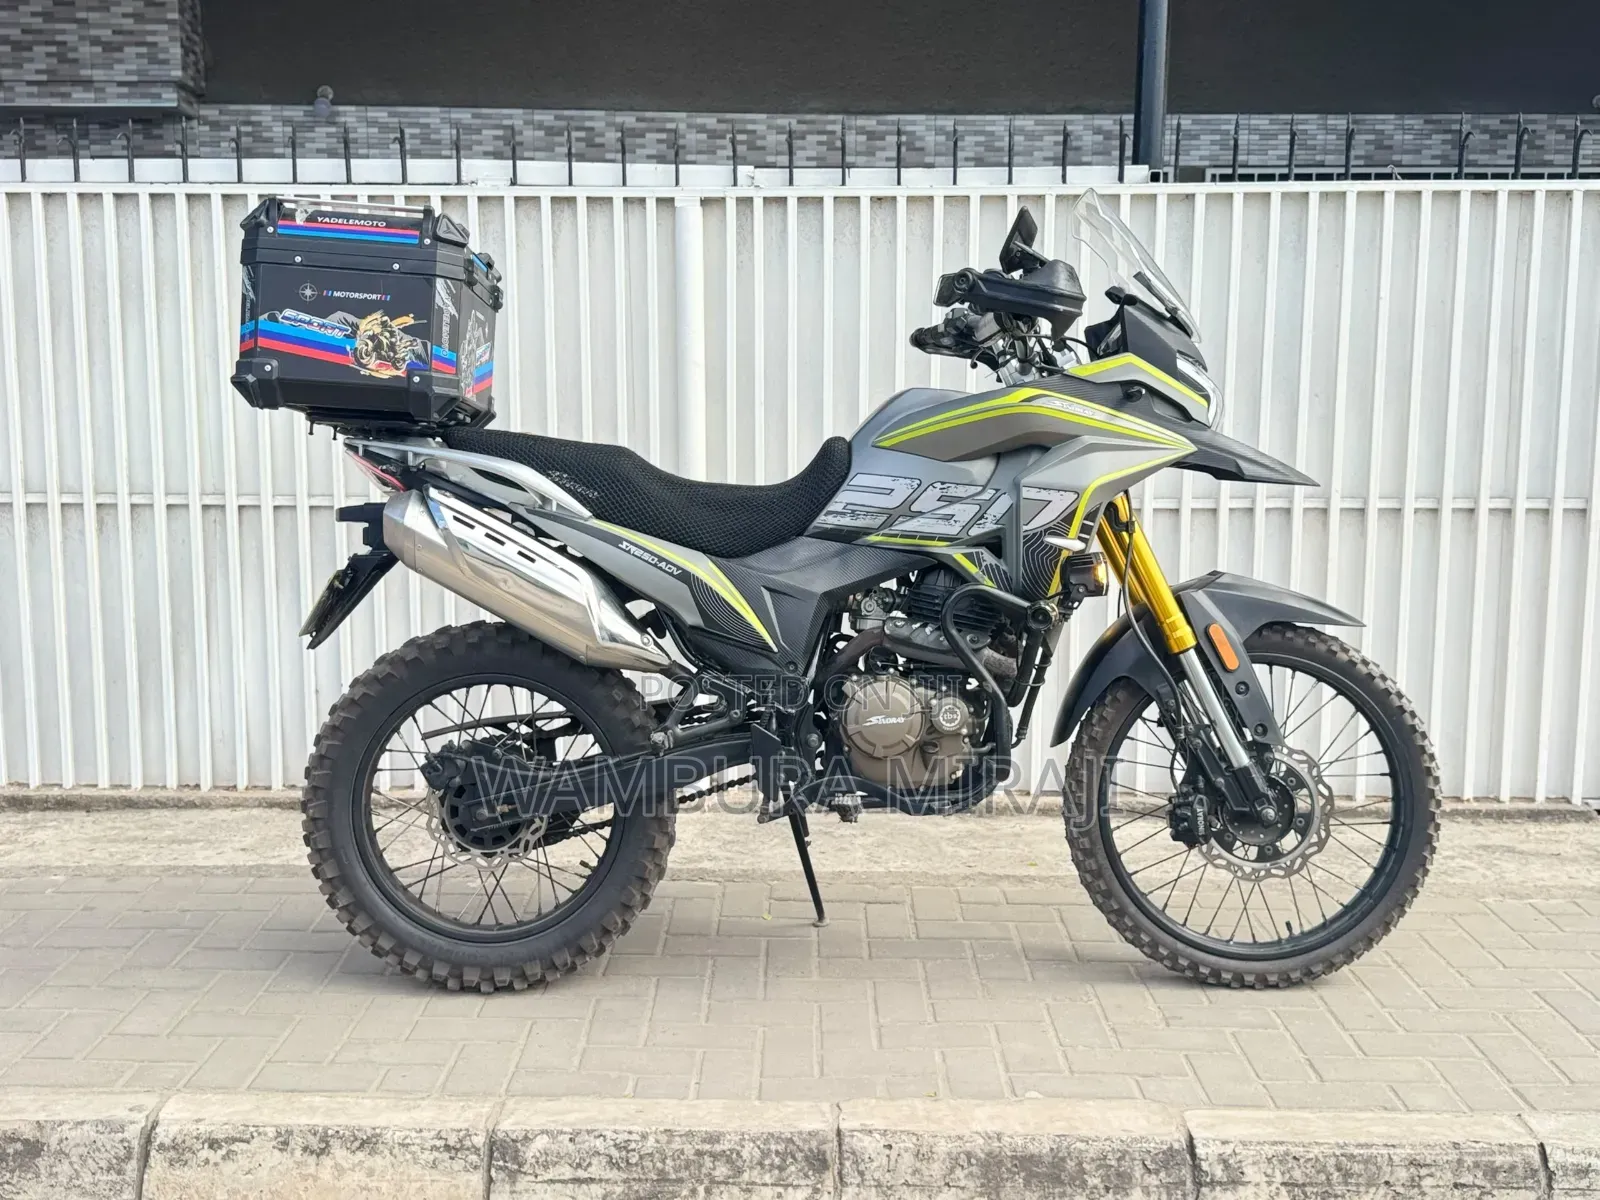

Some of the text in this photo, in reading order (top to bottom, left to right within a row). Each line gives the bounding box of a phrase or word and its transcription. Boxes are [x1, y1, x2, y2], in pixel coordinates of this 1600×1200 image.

[317, 216, 386, 227] YADELEMOTO
[333, 290, 381, 300] MOTORSPORT
[280, 309, 351, 338] SPORT
[618, 540, 682, 575] SR250-ADV
